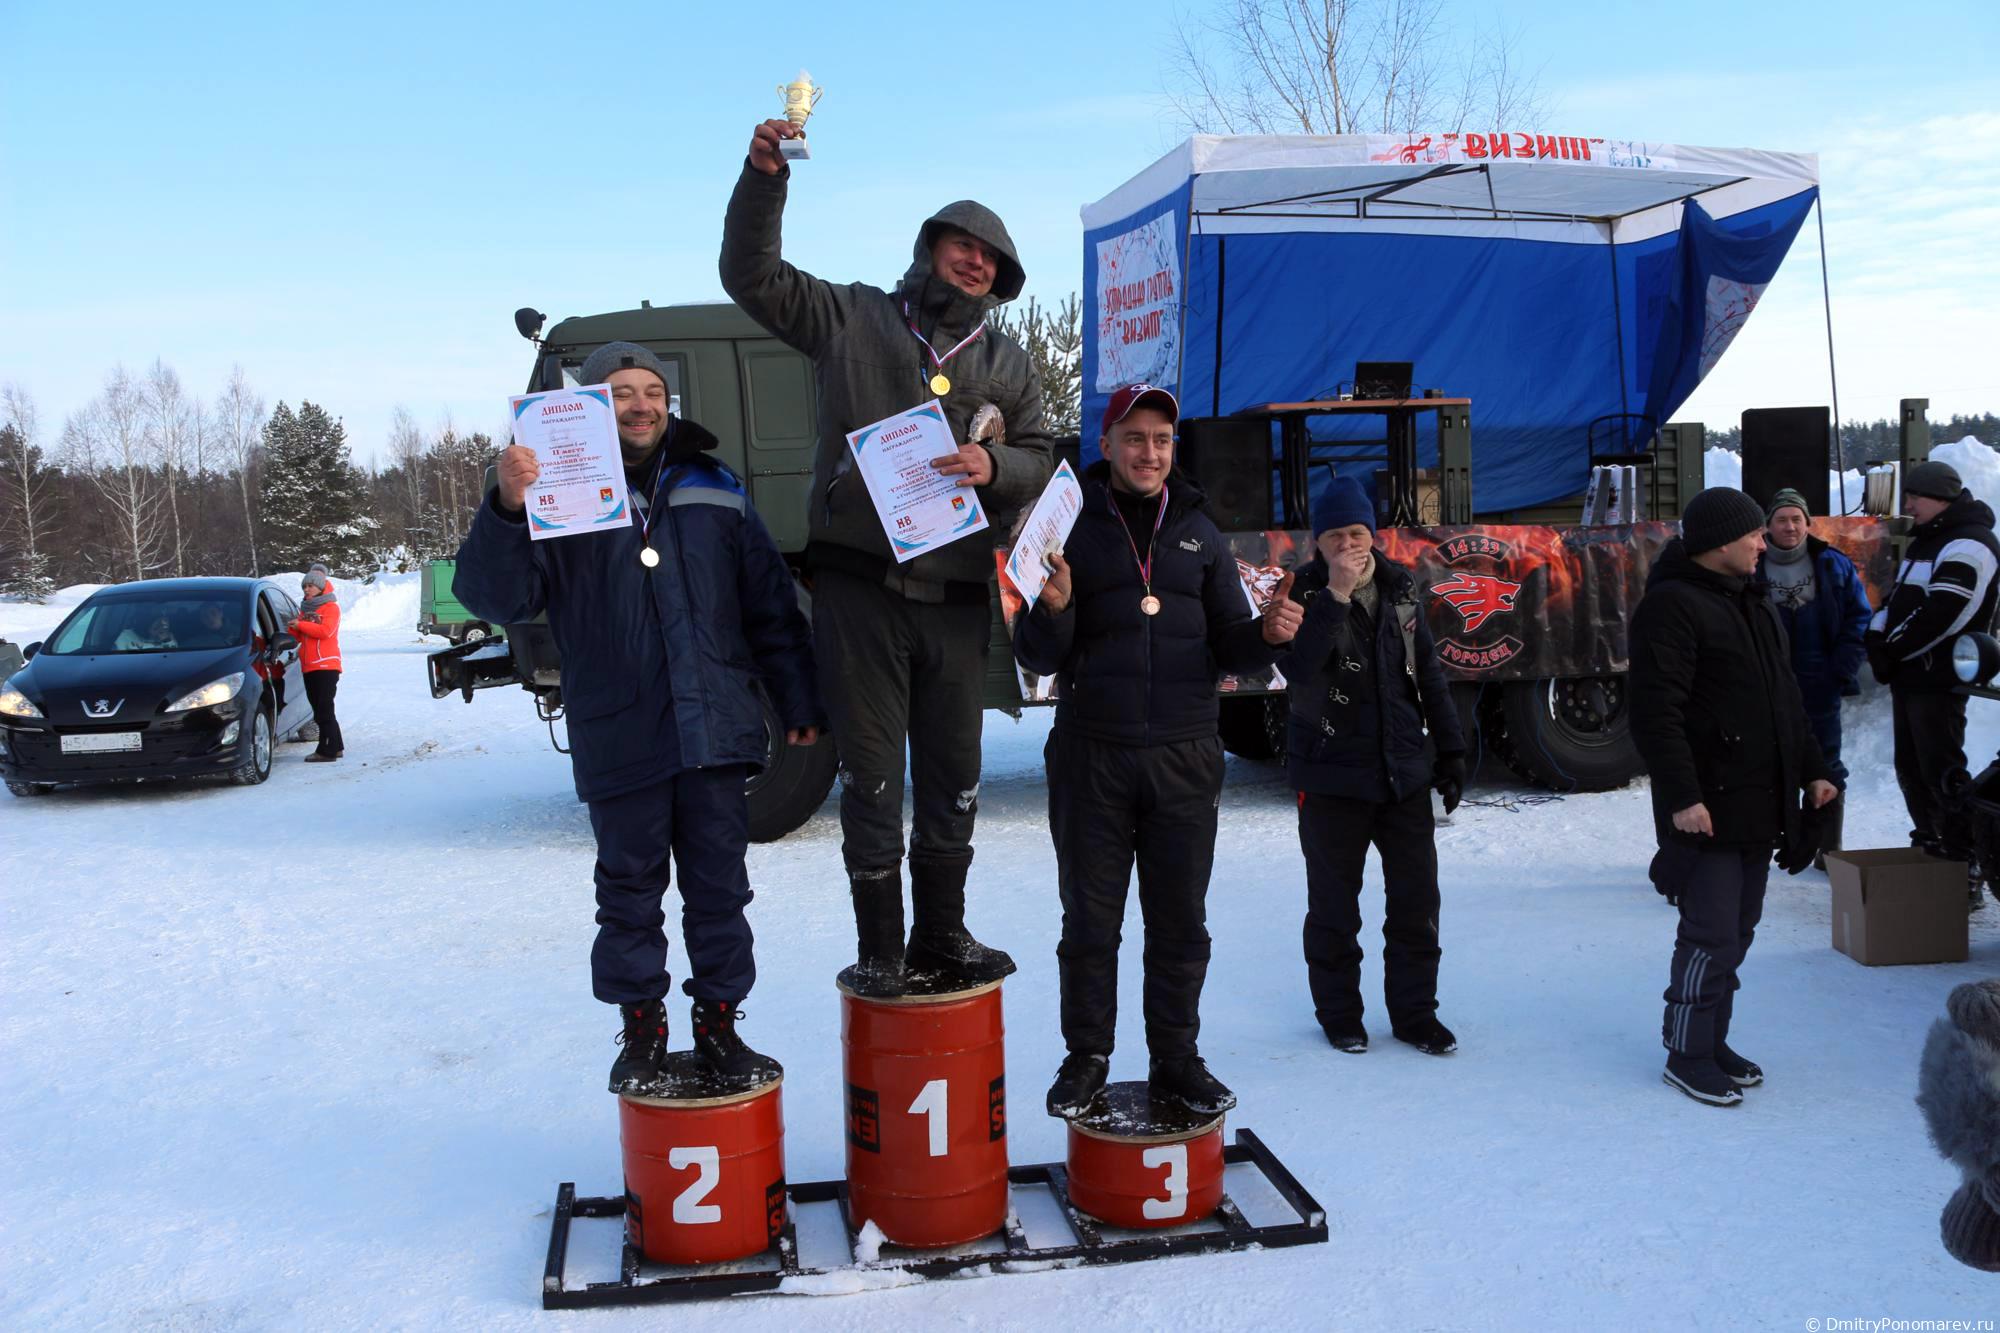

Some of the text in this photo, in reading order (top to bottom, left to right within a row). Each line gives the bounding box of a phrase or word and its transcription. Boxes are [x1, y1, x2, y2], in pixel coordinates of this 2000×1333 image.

[541, 401, 584, 417] ДИПЛОМ
[880, 423, 919, 445] ДИПЛОМ
[1442, 642, 1512, 666] ГОРОДЕЦ
[907, 1079, 948, 1157] 1
[668, 1145, 722, 1224] 2
[1142, 1143, 1189, 1220] 3
